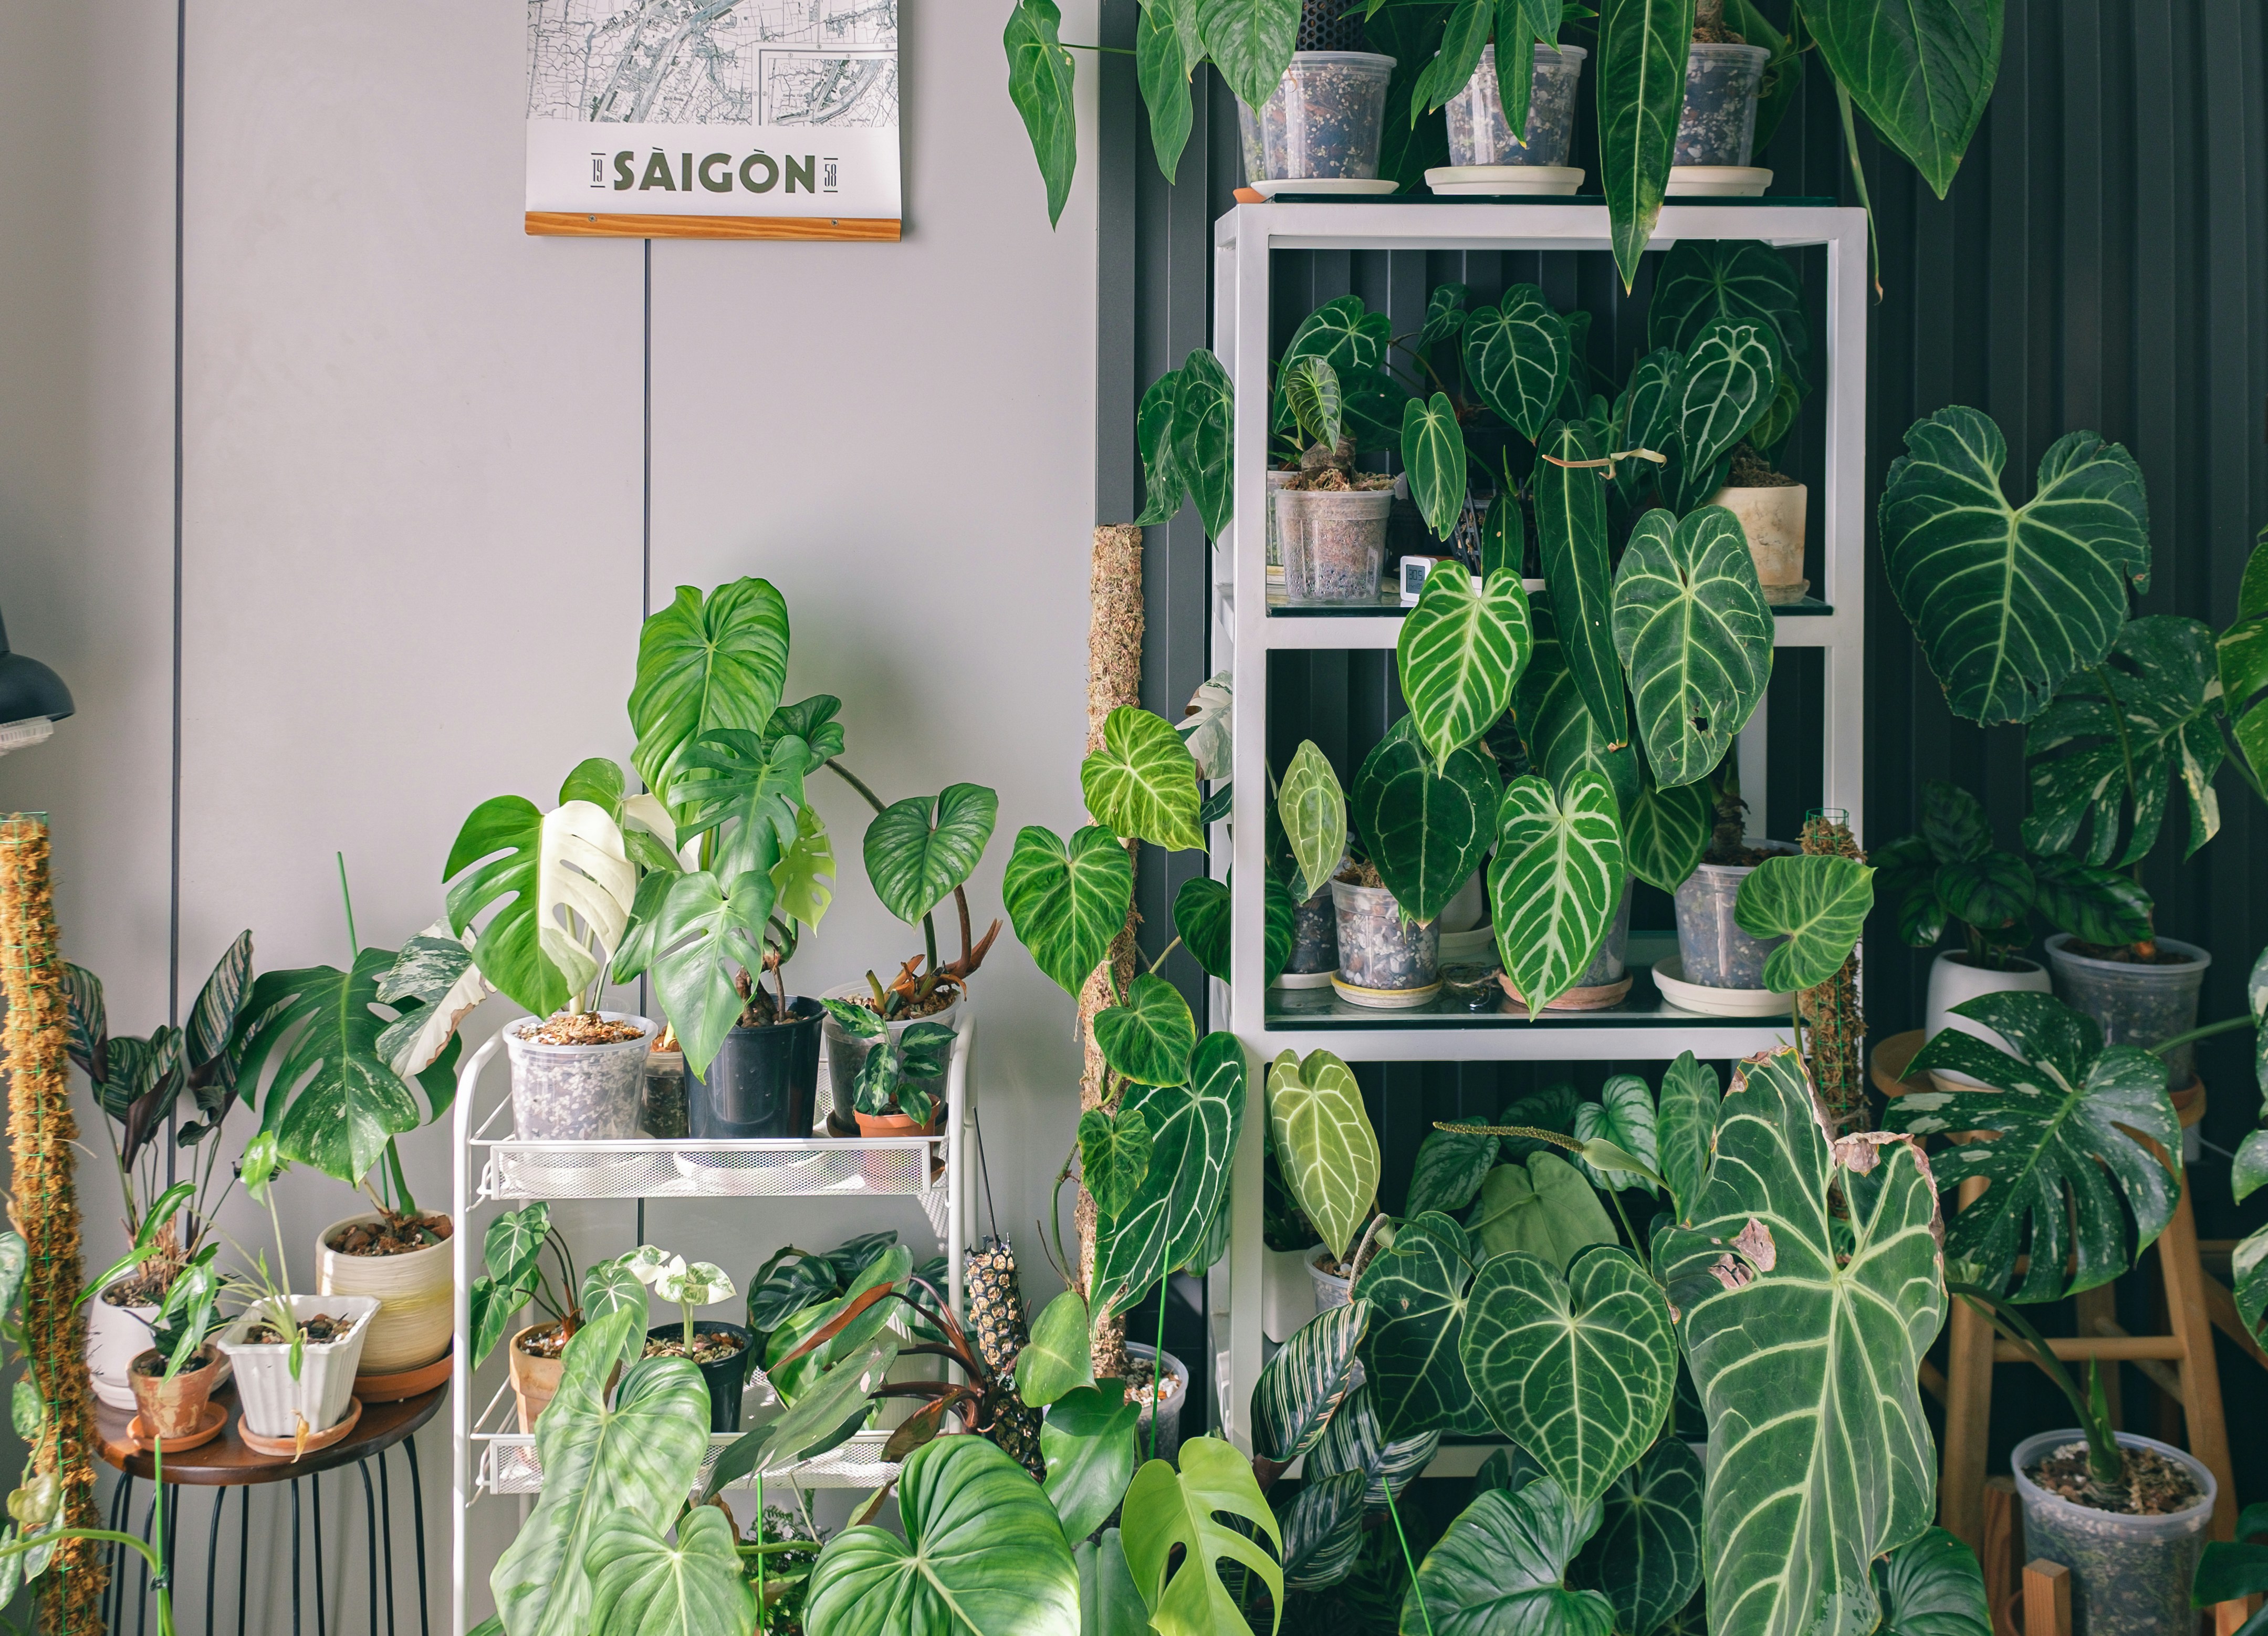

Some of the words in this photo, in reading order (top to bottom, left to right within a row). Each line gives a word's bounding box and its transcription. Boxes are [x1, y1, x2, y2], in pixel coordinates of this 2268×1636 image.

[592, 159, 602, 182] 19
[614, 147, 816, 194] SÀIGÒN
[824, 164, 837, 187] 58
